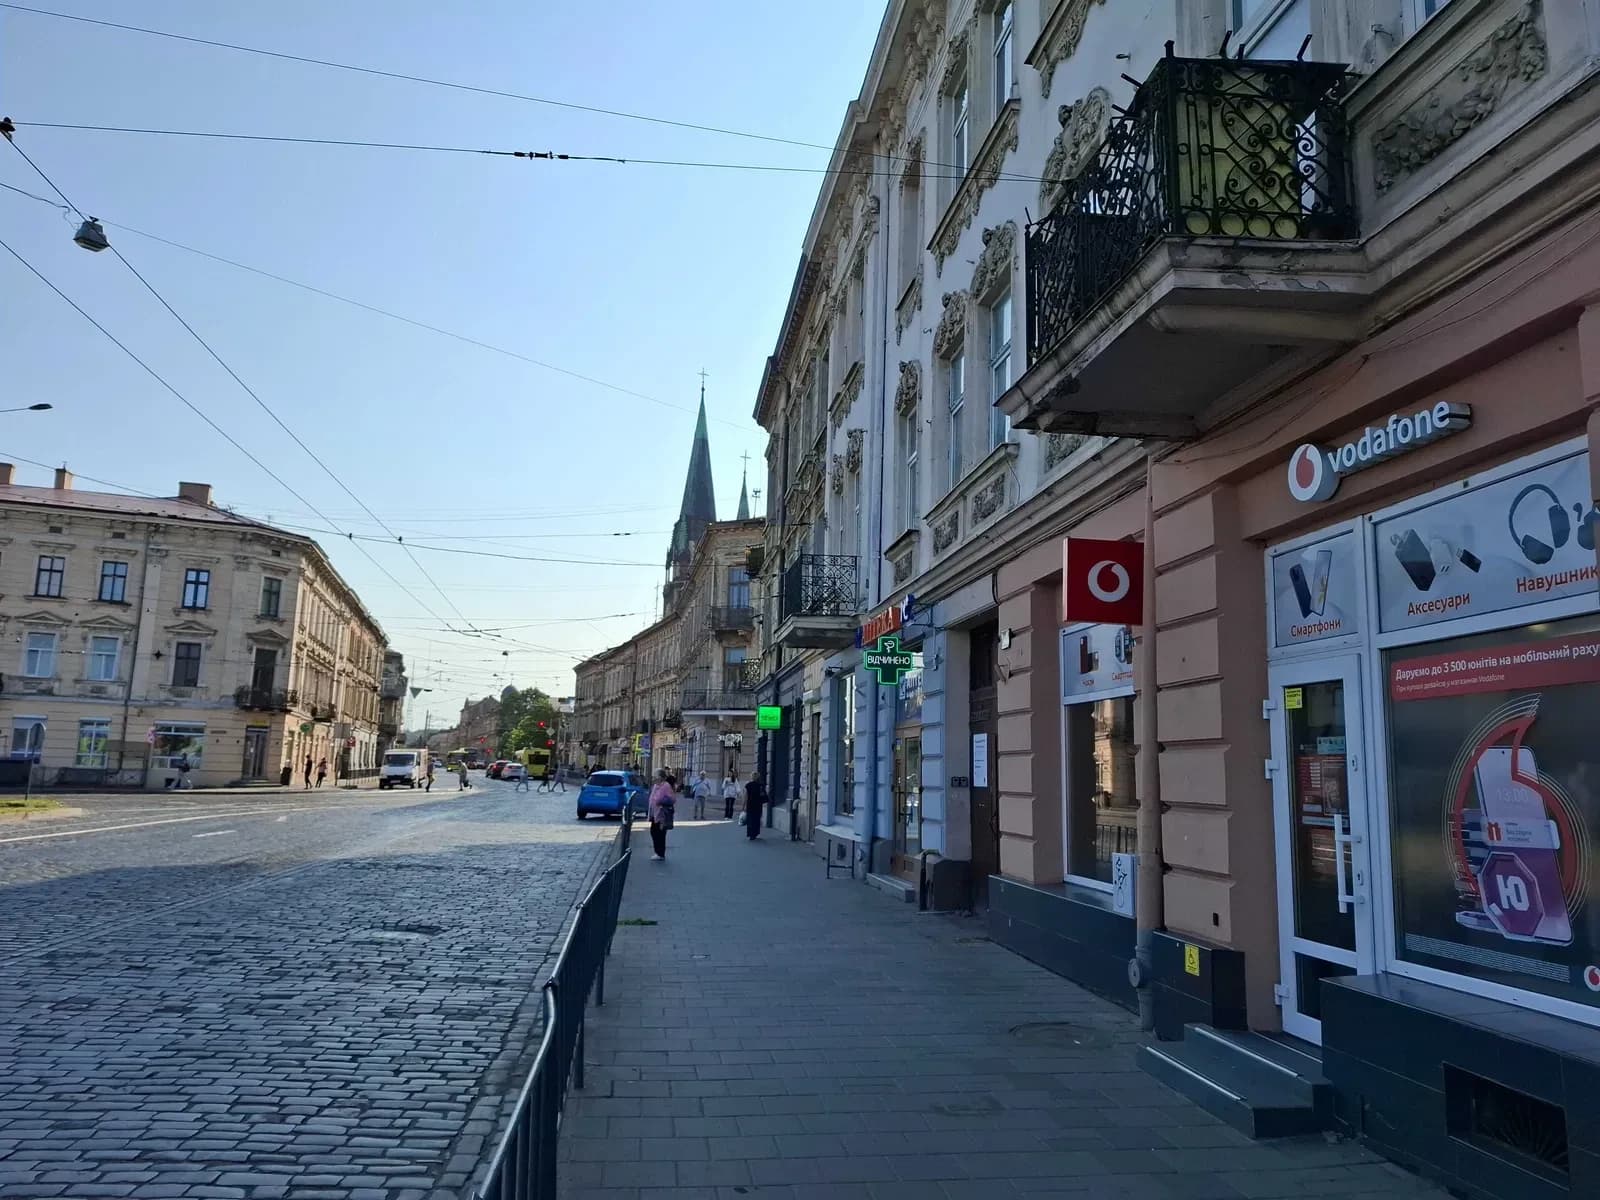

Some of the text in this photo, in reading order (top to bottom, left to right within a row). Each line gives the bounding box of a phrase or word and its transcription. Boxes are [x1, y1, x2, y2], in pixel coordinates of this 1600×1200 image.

[1328, 401, 1450, 473] vodafone
[1407, 593, 1471, 616] Аксесуари
[1290, 618, 1341, 637] Смартфони
[867, 655, 910, 665] ВІДЧИНЕНО
[1395, 668, 1430, 681] Даруємо
[1431, 666, 1442, 676] до
[1443, 662, 1449, 673] 3
[1450, 660, 1467, 672] 500
[1468, 657, 1498, 670] юнітів
[1499, 655, 1511, 665] на
[1513, 645, 1570, 664] мобільний
